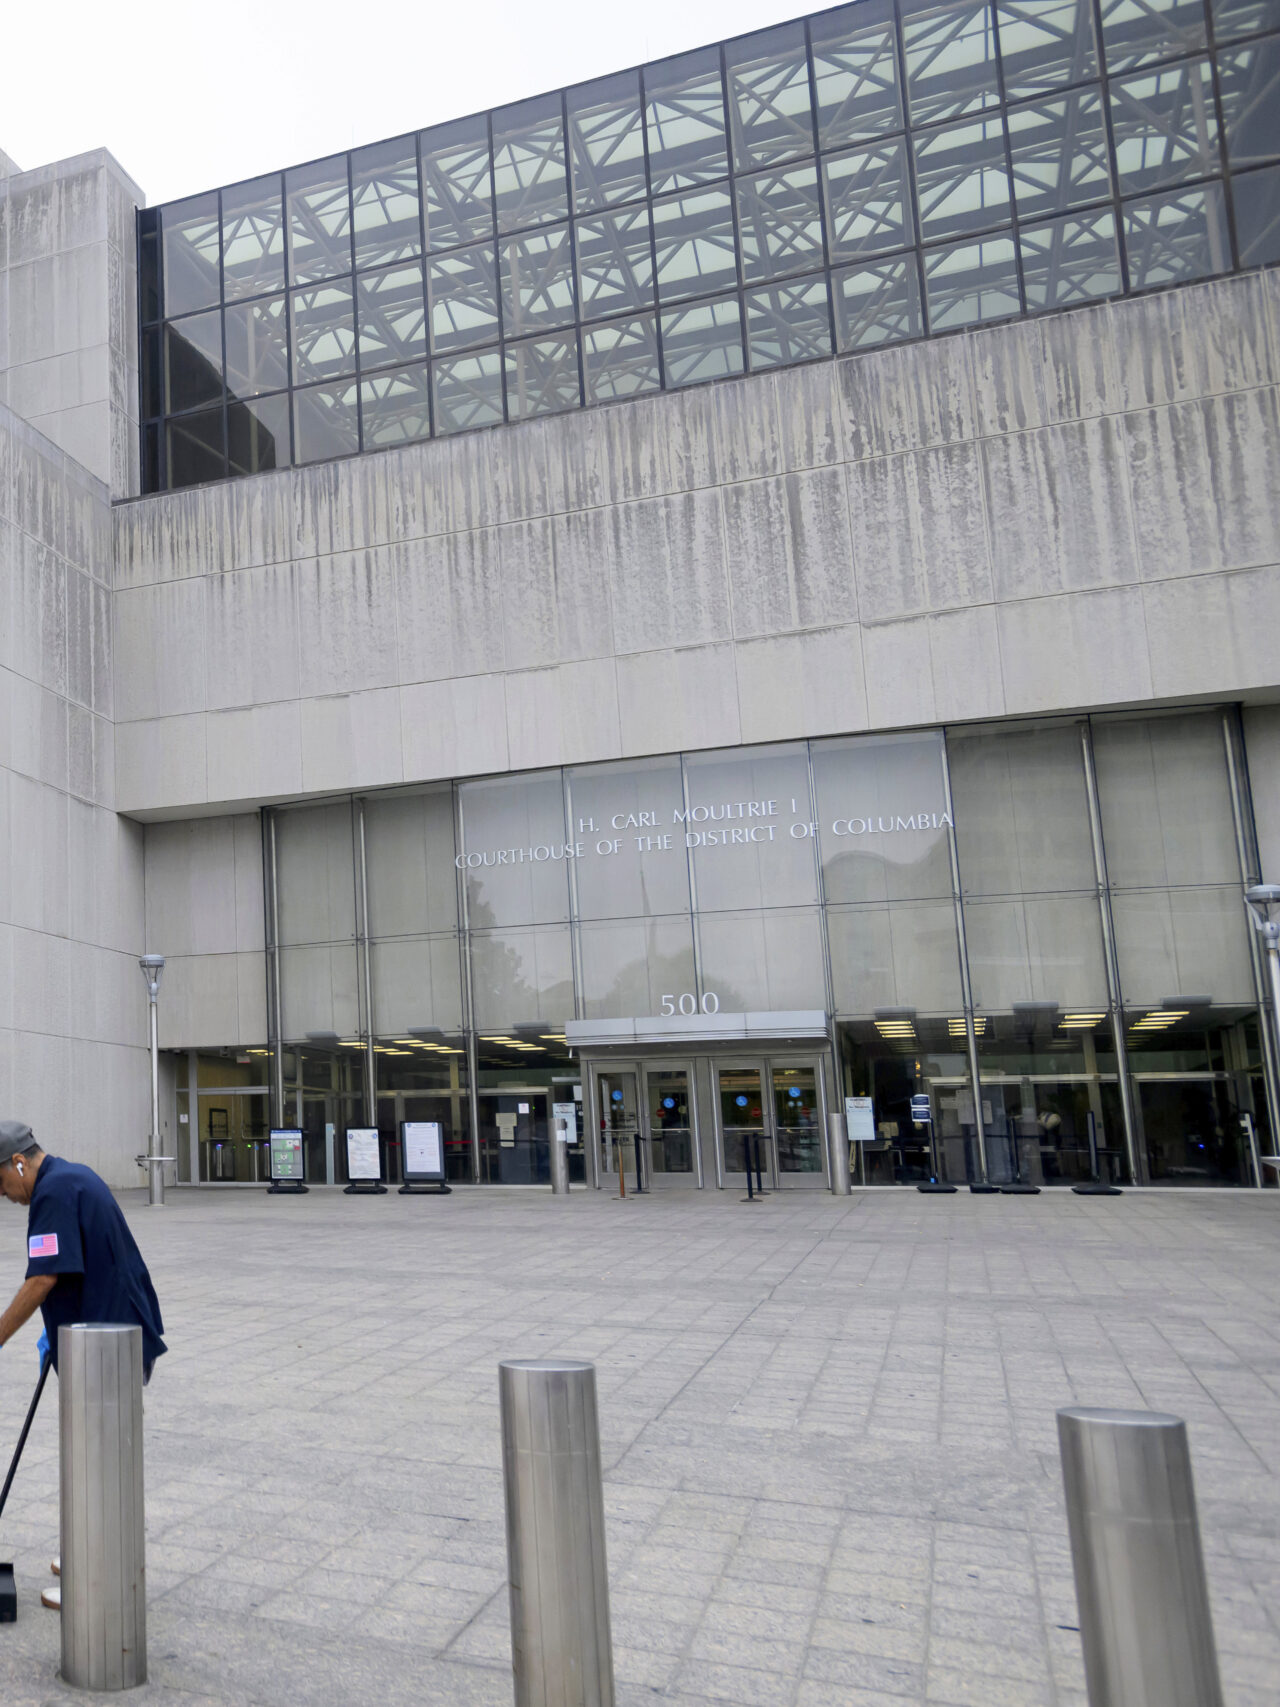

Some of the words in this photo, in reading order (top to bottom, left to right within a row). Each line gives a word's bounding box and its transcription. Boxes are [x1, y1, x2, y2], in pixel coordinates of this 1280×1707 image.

[579, 817, 600, 833] H.
[611, 810, 662, 830] CARL
[673, 799, 779, 824] MOULTRIE
[791, 798, 796, 813] I
[454, 842, 585, 869] COURTHOUSE
[596, 838, 623, 856] OF
[634, 834, 673, 851] THE
[685, 825, 777, 849] DISTRICT
[790, 822, 820, 839] OF
[832, 812, 956, 836] COLUMBIA
[660, 992, 719, 1017] 500
